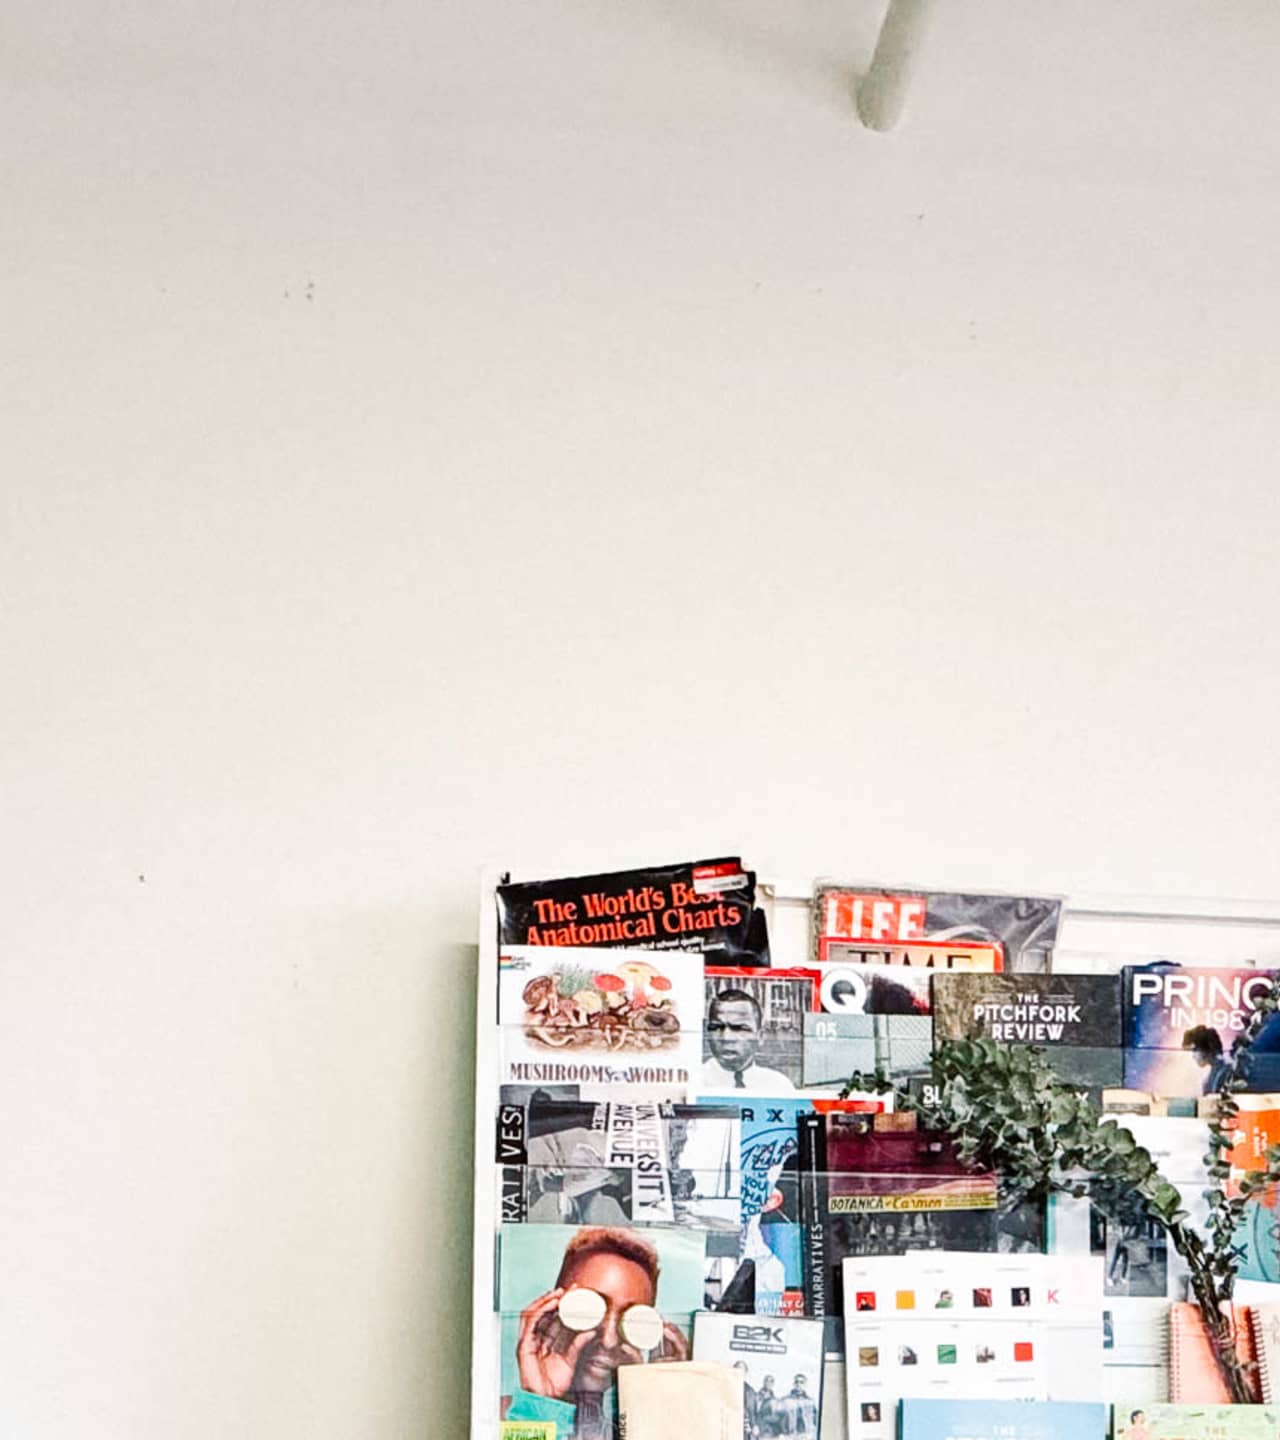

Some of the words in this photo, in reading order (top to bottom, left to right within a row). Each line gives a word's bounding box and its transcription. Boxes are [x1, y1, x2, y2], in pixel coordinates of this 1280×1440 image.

[533, 898, 577, 924] The
[581, 885, 666, 917] World's
[526, 913, 657, 947] Anatomical
[663, 904, 742, 938] Charts
[826, 898, 922, 939] LIFE
[1017, 995, 1039, 1004] THE
[1170, 1008, 1201, 1028] IN
[990, 1024, 1063, 1041] REVIEW
[510, 1062, 612, 1083] MUSHROOMS
[610, 1102, 634, 1164] AVENUE
[634, 1101, 668, 1216] UNIVERSITY
[831, 1196, 884, 1211] BOTANICA
[732, 1324, 784, 1344] B2K
[503, 1429, 547, 1440] AFRICAN
